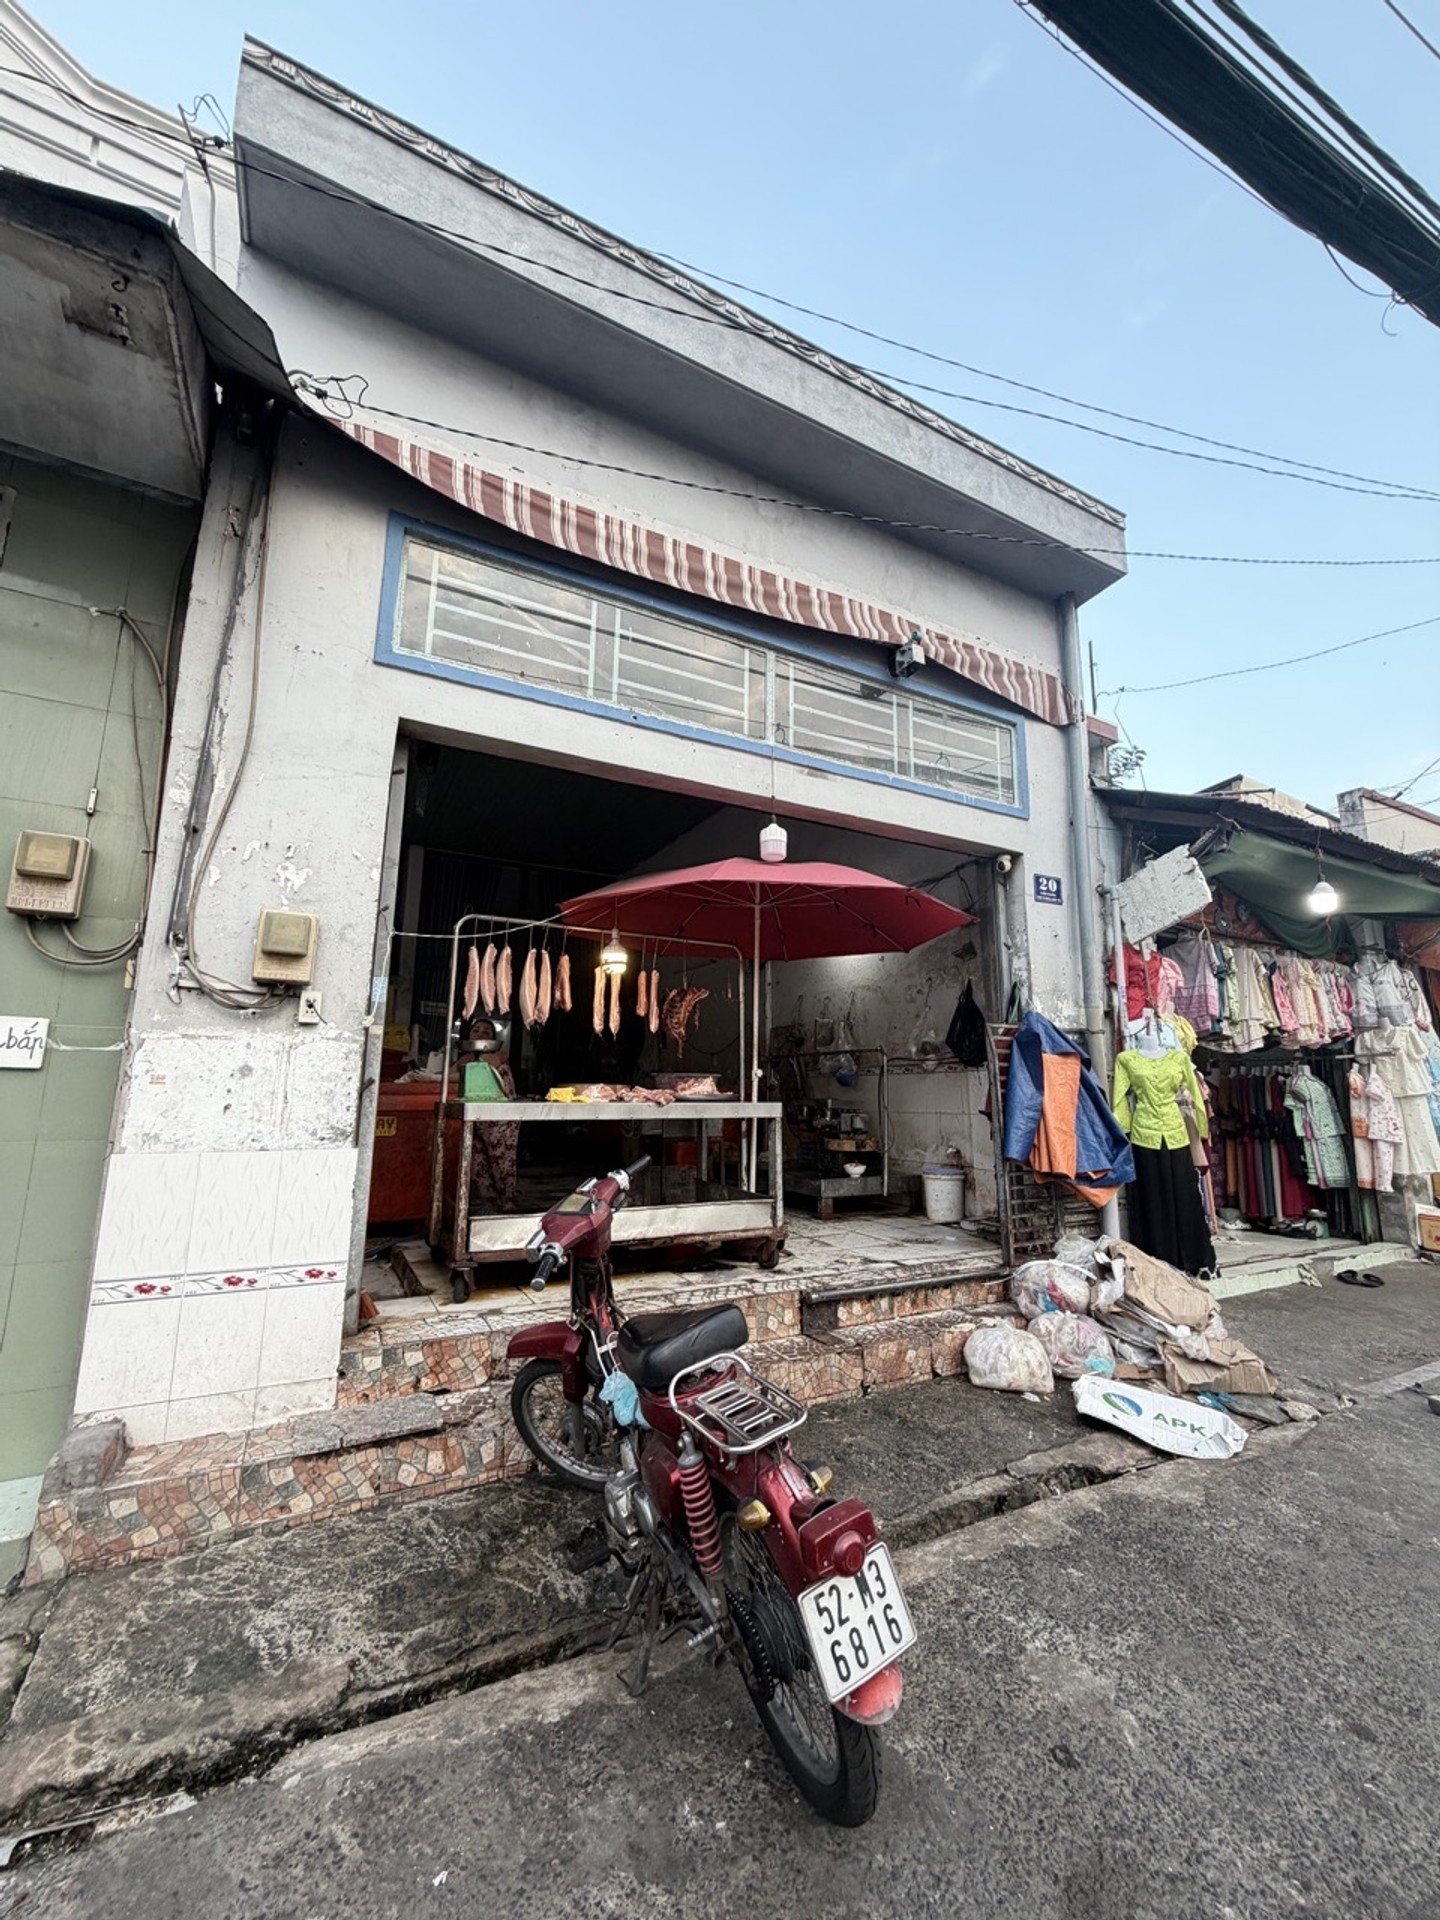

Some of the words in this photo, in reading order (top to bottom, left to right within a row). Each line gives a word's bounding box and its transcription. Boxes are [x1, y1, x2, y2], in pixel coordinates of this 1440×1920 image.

[1039, 877, 1058, 892] 20
[1153, 1412, 1208, 1438] APK
[813, 1559, 887, 1635] 52-M3
[830, 1603, 903, 1683] 6816
